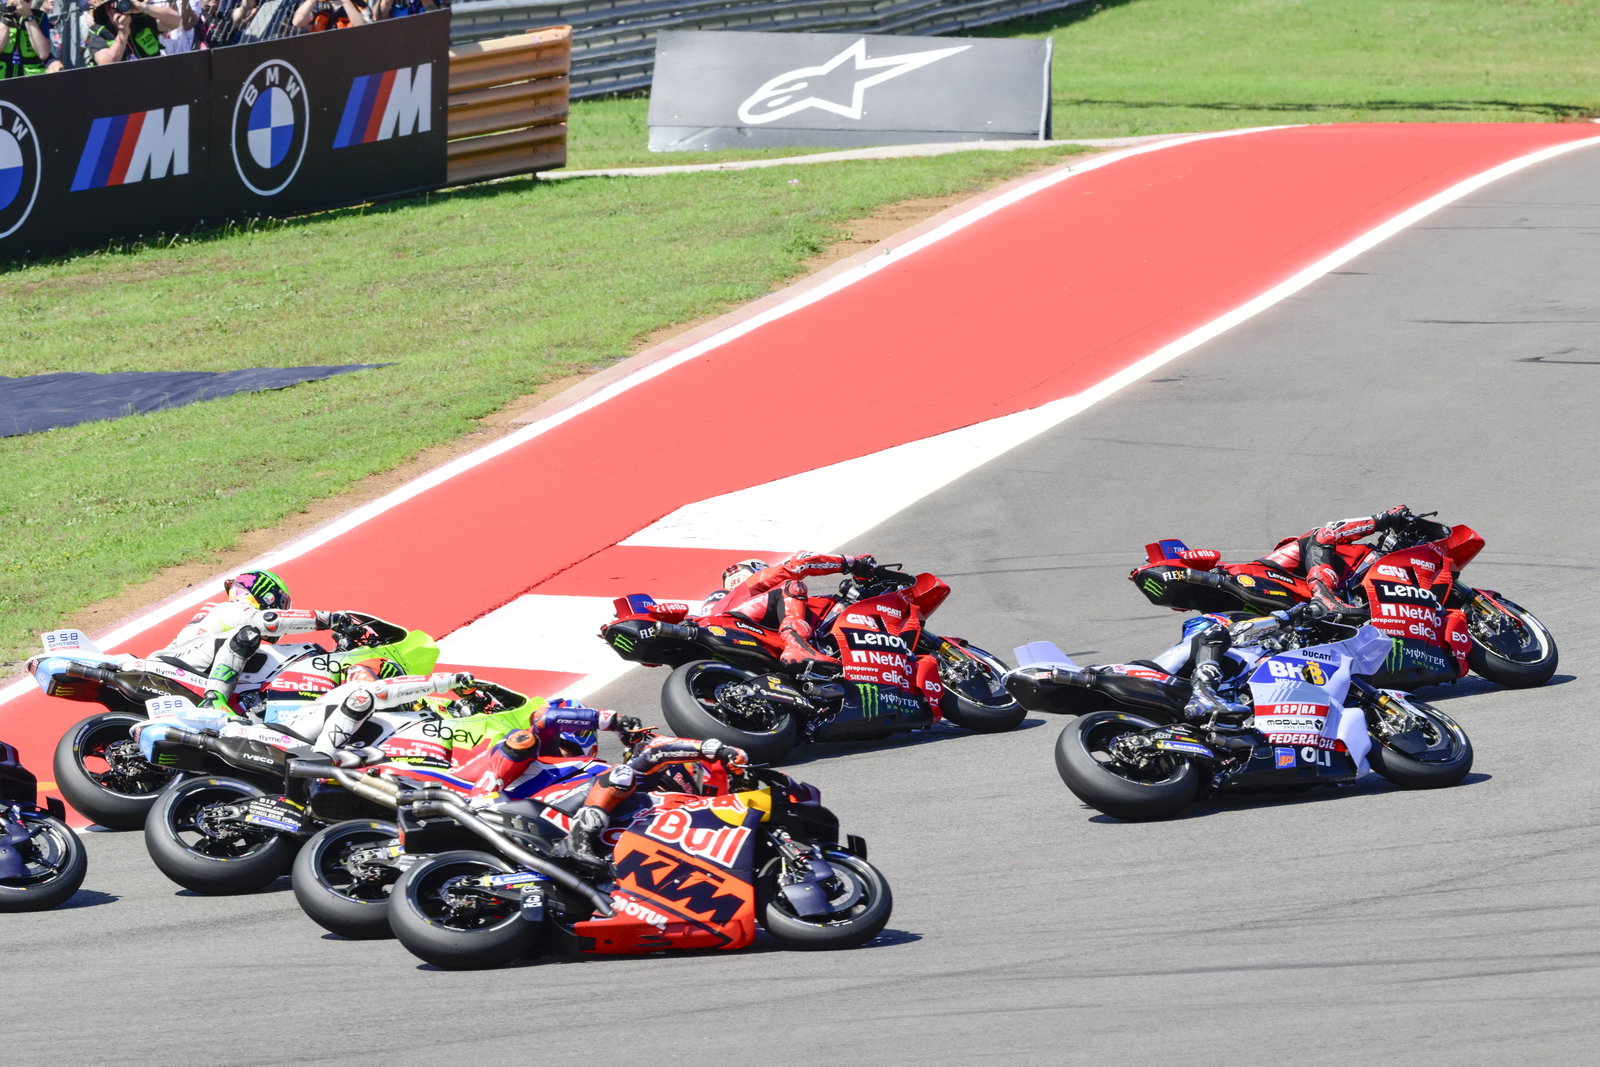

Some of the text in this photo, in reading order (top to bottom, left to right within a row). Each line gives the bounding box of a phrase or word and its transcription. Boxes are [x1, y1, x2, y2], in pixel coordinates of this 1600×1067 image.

[244, 67, 300, 107] BMW
[1410, 558, 1436, 570] DUCATI
[876, 604, 902, 617] DUCATI
[1380, 628, 1405, 636] IEMENS
[1408, 622, 1437, 641] elica
[1302, 649, 1331, 661] DUCATI
[312, 653, 352, 675] eb
[849, 673, 878, 682] SIEMENS
[881, 670, 910, 689] elica
[271, 678, 328, 692] Endu
[1273, 704, 1318, 716] ASPIRA
[422, 720, 484, 748] ebay
[1268, 733, 1319, 745] FEDERAL
[243, 752, 275, 765] IVECO
[645, 808, 752, 869] Bull
[616, 849, 746, 928] KTM
[610, 895, 670, 931] MOTUL
